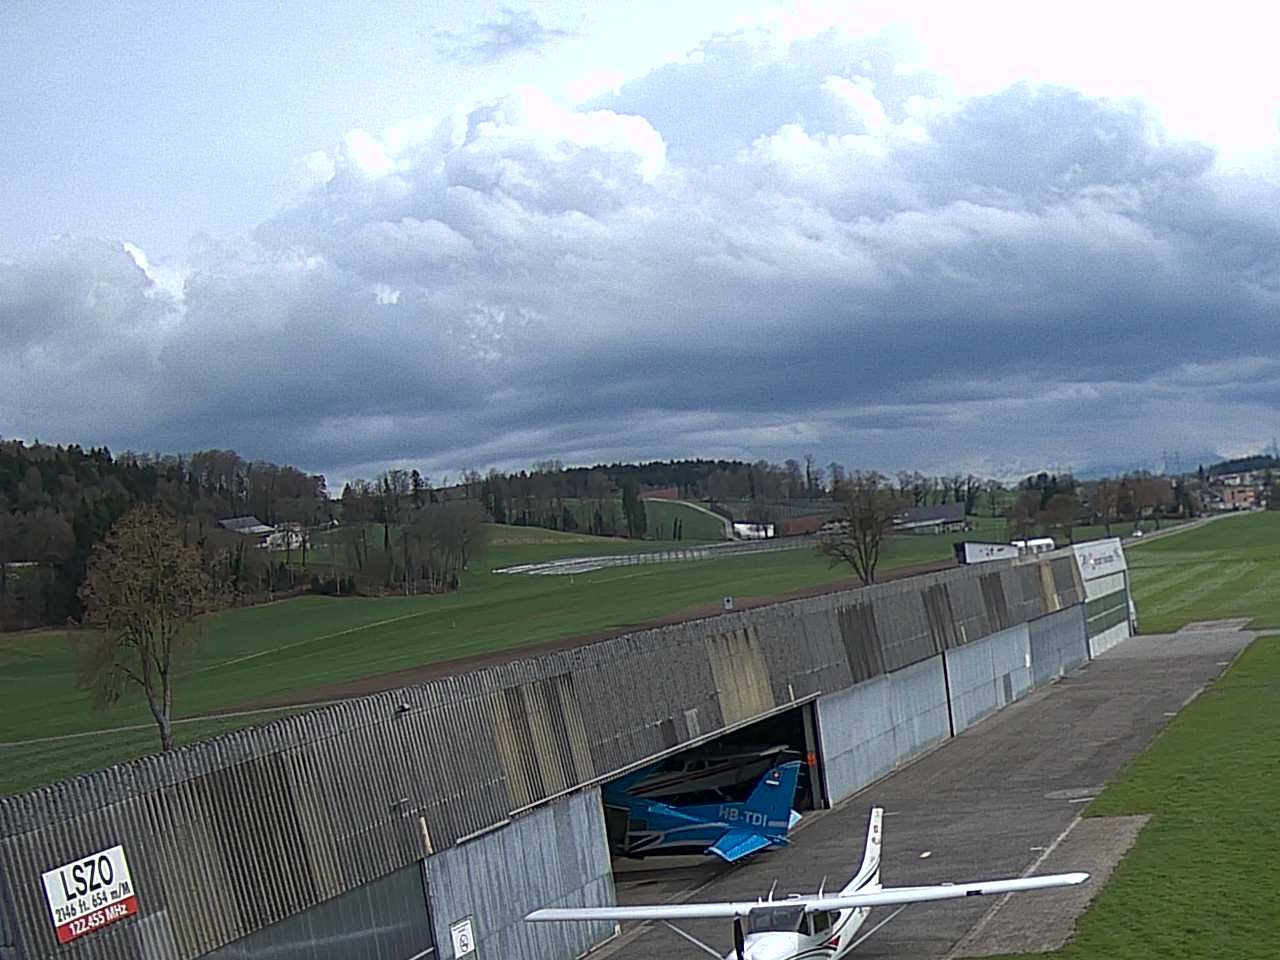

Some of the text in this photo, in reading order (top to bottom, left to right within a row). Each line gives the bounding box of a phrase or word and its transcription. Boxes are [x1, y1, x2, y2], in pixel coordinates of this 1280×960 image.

[719, 804, 768, 827] HB-TDI
[60, 855, 114, 901] LSZO
[55, 904, 76, 922] 2146
[92, 890, 108, 908] 654
[69, 904, 128, 936] 122.455 MHz
